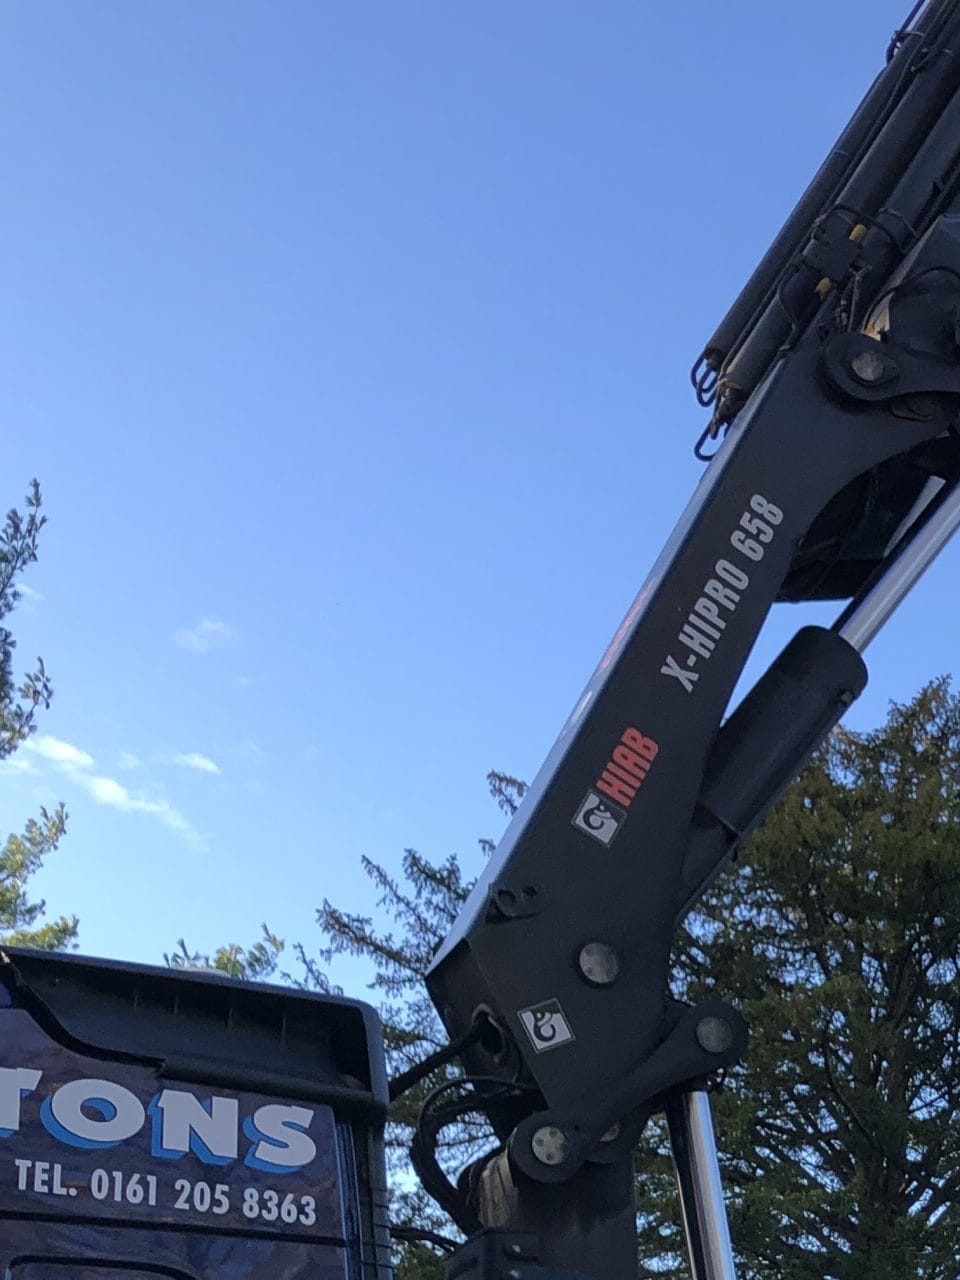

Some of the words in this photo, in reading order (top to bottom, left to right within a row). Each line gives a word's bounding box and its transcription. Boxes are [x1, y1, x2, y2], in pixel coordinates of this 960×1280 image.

[661, 558, 750, 693] X-HIPRO
[730, 493, 784, 562] 658
[596, 727, 659, 807] HIAB
[15, 1159, 78, 1197] TEL.
[90, 1168, 157, 1206] 0161
[174, 1178, 230, 1215] 205
[242, 1187, 317, 1226] 8363
